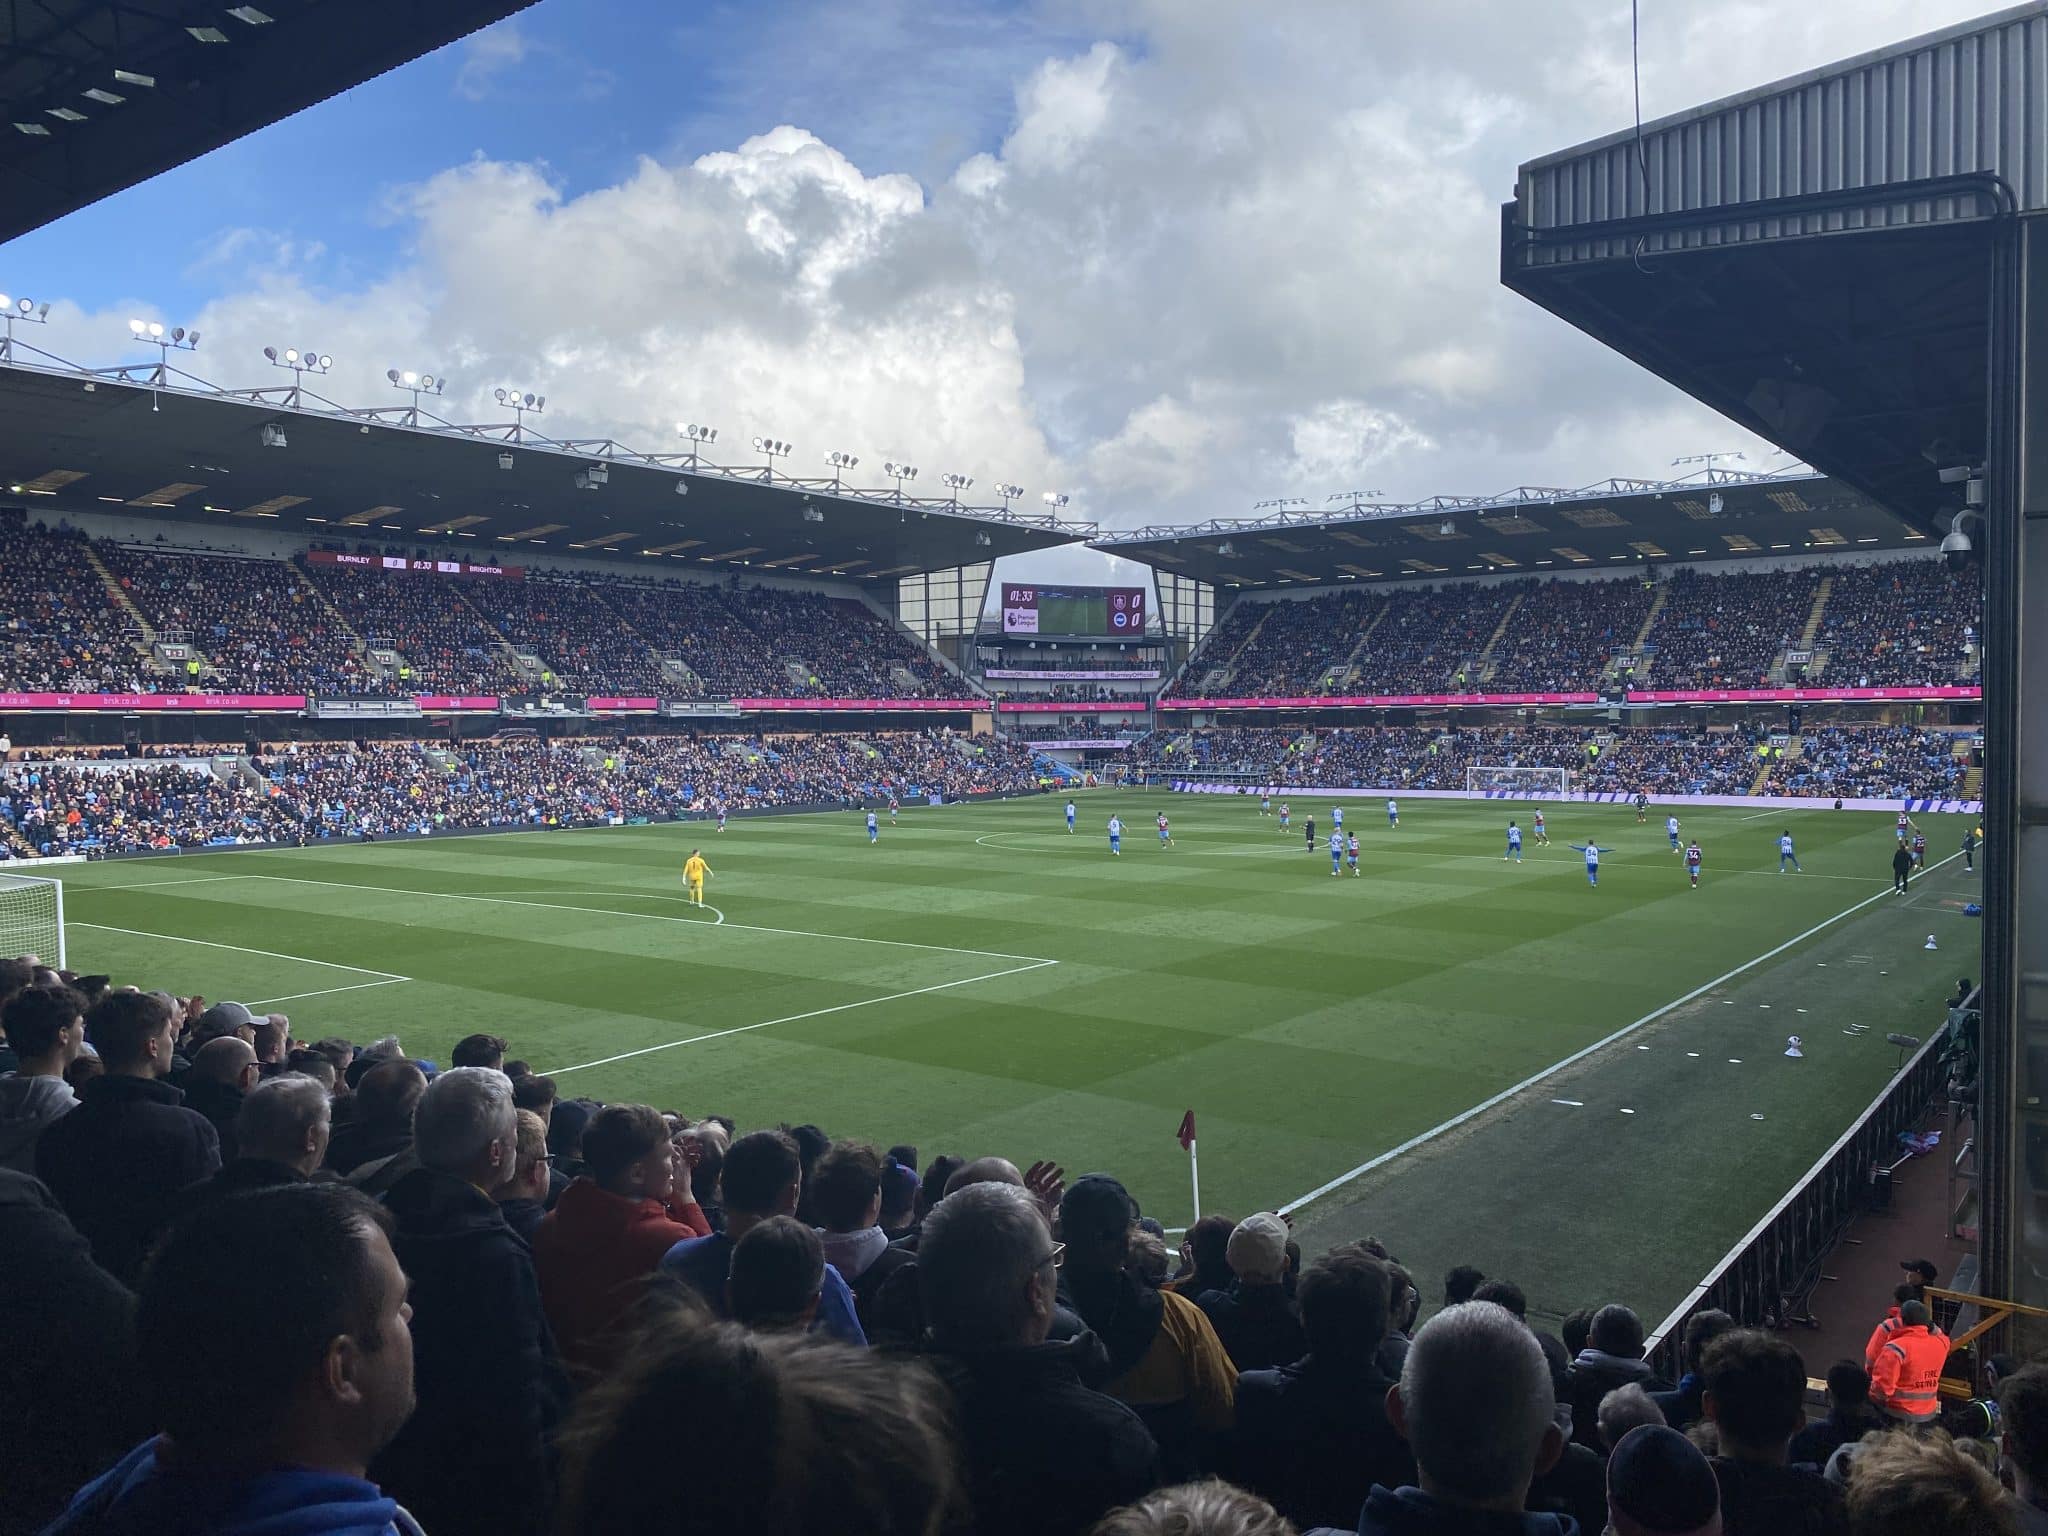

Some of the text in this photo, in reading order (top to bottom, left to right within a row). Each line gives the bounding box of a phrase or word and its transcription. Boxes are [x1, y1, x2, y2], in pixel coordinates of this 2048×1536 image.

[336, 554, 371, 564] BURNLEY
[469, 565, 502, 575] BRIGHTON
[1009, 590, 1033, 602] 01:33
[1131, 594, 1141, 608] 0
[1017, 613, 1036, 621] Premier
[1130, 612, 1141, 627] 0
[1017, 620, 1036, 628] League
[1104, 671, 1155, 679] @BurnleyOfficial
[103, 697, 141, 706] brsk.co.uk
[205, 697, 240, 706] brsk.co.uk
[1924, 1369, 1938, 1380] FIRE
